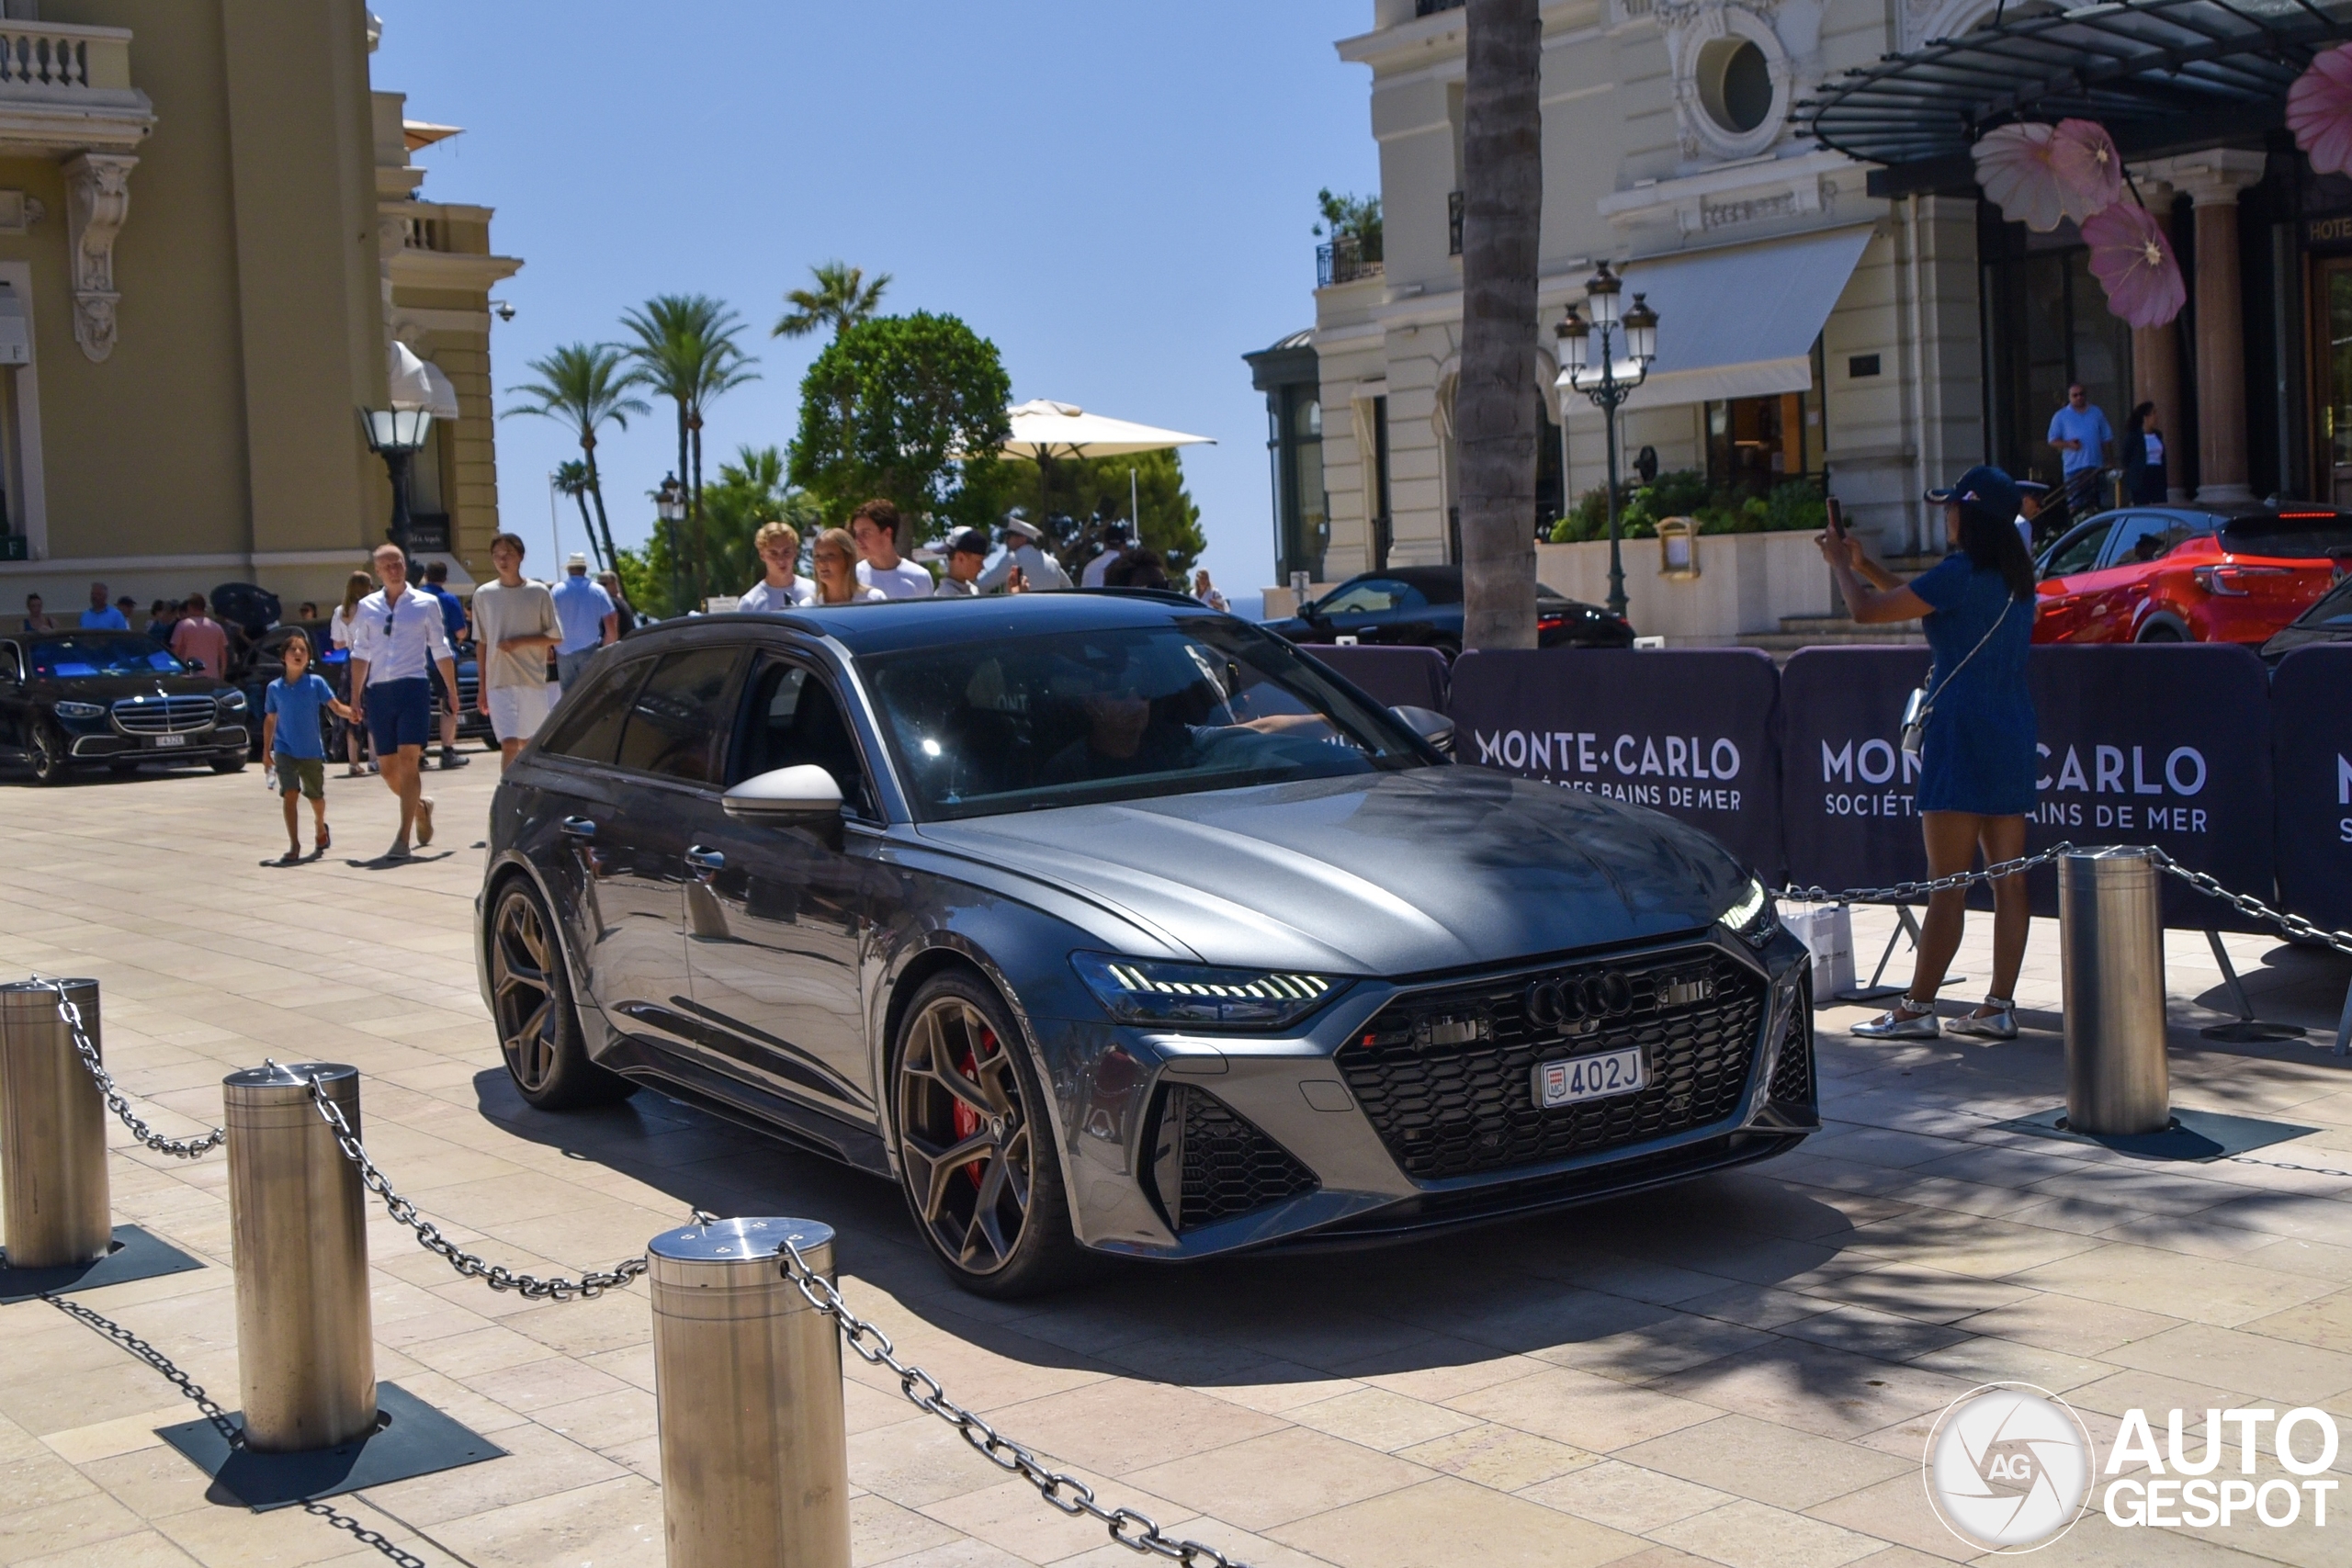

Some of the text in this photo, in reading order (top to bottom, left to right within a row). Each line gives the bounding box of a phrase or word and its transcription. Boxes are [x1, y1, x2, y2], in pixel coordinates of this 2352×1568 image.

[1601, 783, 1661, 805] BAINS
[1668, 786, 1692, 807] DE
[1698, 788, 1741, 811] MER
[1825, 789, 1924, 817] SOCIÉT
[2096, 805, 2134, 829] DE
[2147, 807, 2207, 833] MER
[1550, 1083, 1563, 1093] MC
[1570, 1053, 1637, 1095] 402J
